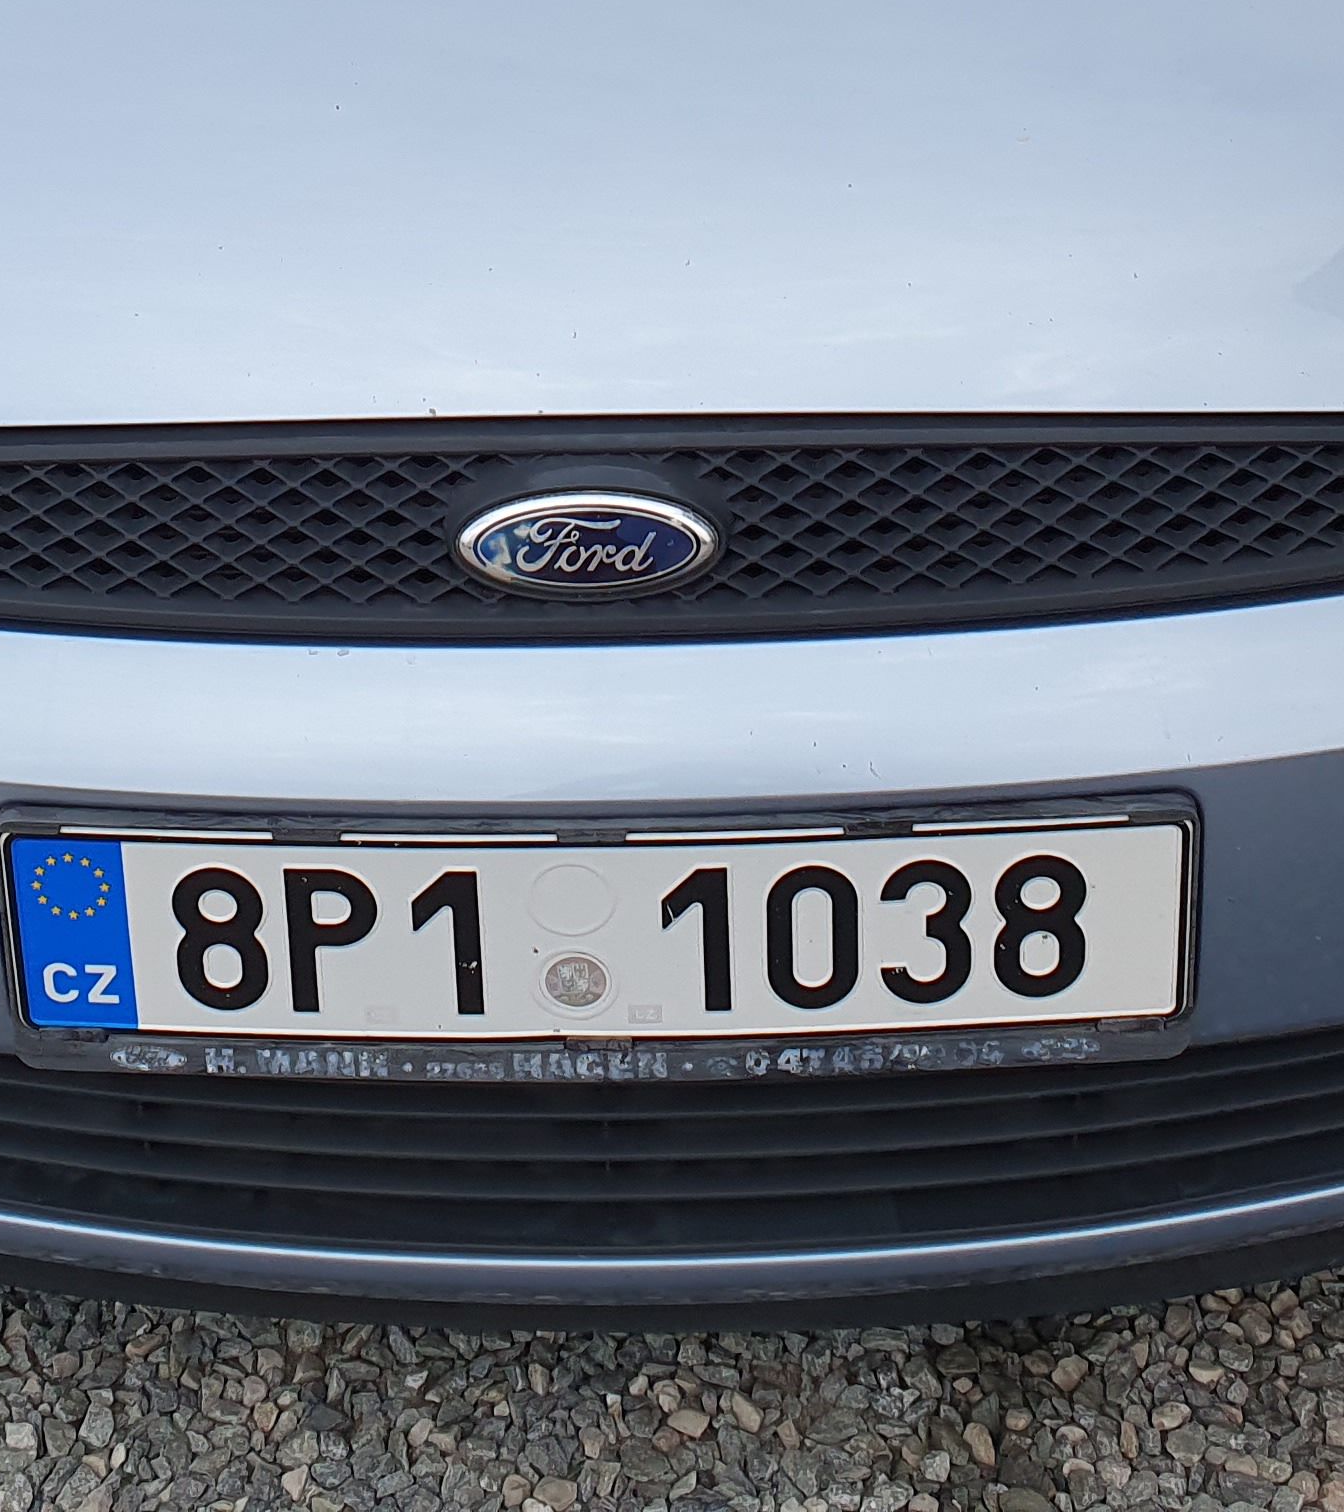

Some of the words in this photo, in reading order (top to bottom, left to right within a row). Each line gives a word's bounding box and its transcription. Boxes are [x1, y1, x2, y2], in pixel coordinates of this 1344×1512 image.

[515, 517, 657, 573] Ford
[171, 866, 486, 1015] 8P1
[660, 854, 1089, 1013] 1038
[42, 962, 121, 1005] CZ
